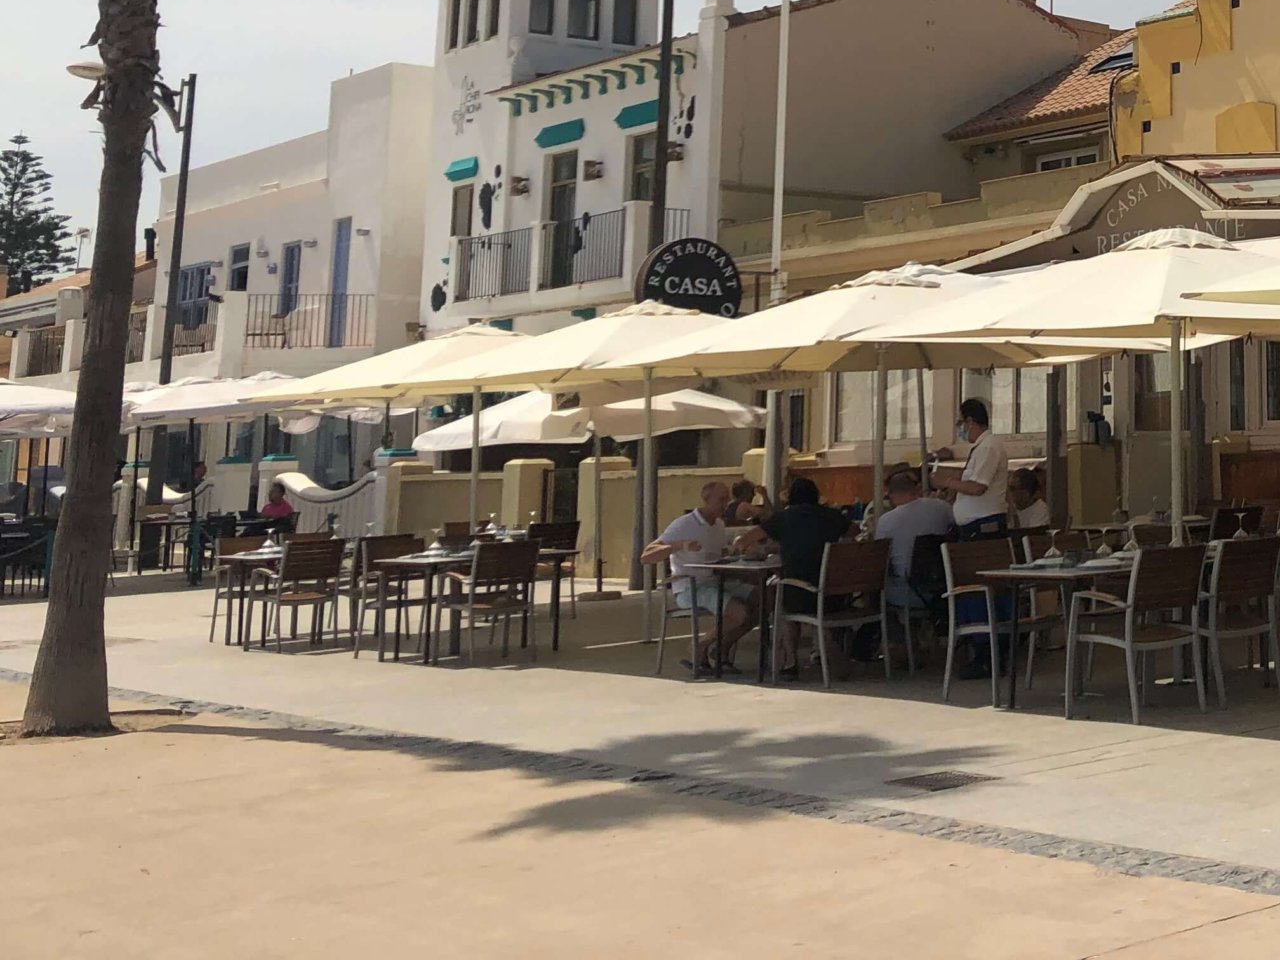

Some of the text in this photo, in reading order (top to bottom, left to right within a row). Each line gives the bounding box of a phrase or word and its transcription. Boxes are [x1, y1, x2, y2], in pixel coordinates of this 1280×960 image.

[1106, 182, 1148, 227] CASA
[648, 243, 737, 288] RESTAURANT
[664, 276, 723, 296] CASA
